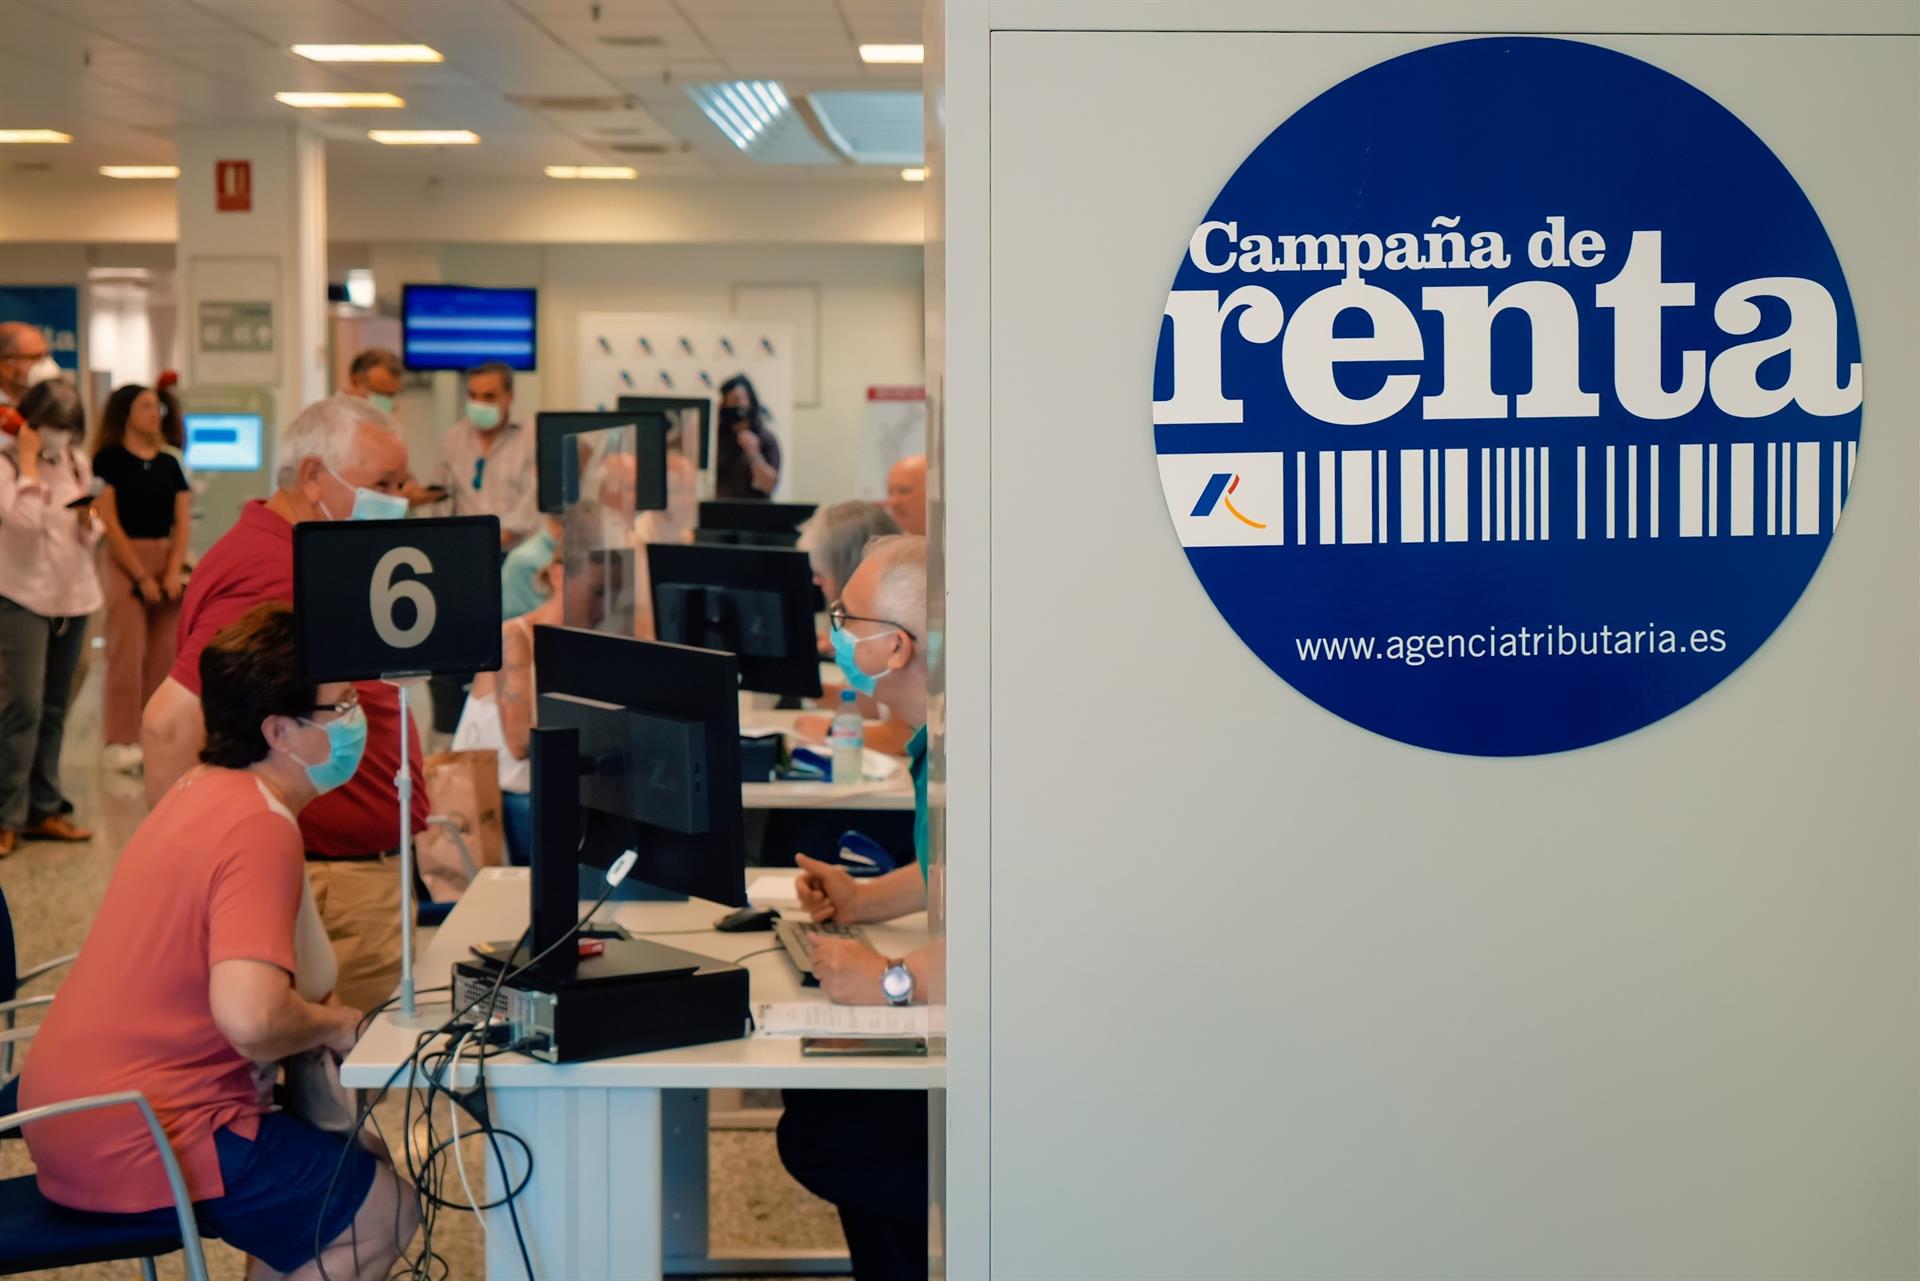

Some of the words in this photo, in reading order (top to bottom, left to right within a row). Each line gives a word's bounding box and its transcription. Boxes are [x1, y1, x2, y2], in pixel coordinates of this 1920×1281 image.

[1190, 215, 1512, 286] Campaña
[1527, 215, 1606, 268] de
[1153, 230, 1863, 425] renta
[369, 546, 437, 649] 6
[1295, 622, 1727, 666] www.agenciatributaria.es
